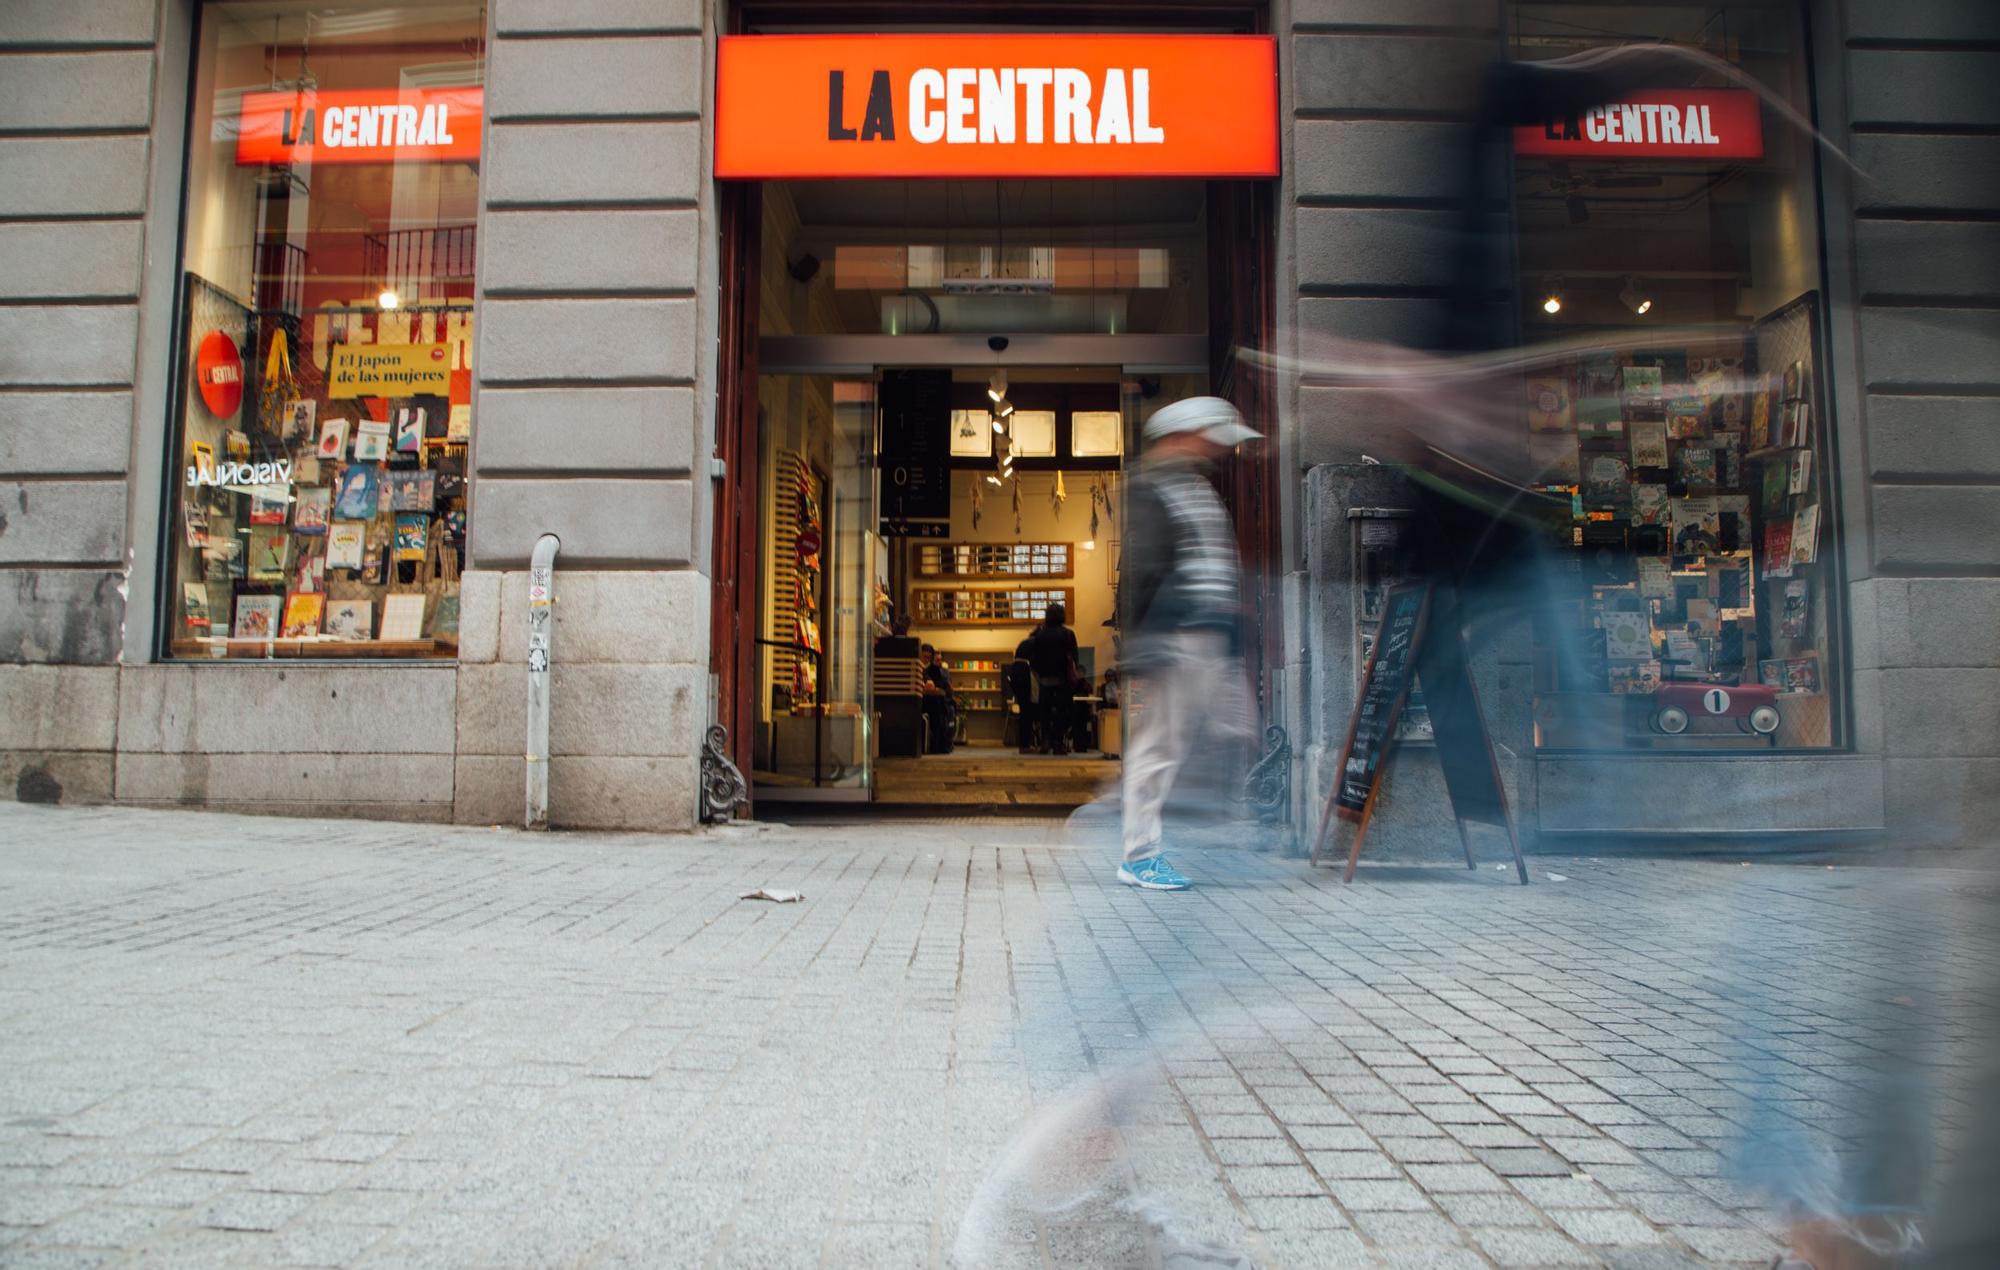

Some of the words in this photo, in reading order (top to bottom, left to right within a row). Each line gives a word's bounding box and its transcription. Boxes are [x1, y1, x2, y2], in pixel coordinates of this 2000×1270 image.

[828, 70, 895, 142] LA
[908, 68, 1165, 145] CENTRAL
[282, 108, 316, 146] LA
[323, 104, 453, 148] CENTRAL
[1585, 103, 1720, 145] CENTRAL
[340, 354, 354, 366] El
[357, 352, 401, 369] Japón
[212, 365, 240, 384] CENTRAL
[337, 371, 355, 383] de
[359, 370, 380, 383] las
[383, 368, 446, 385] mujeres
[1712, 690, 1721, 712] 1
